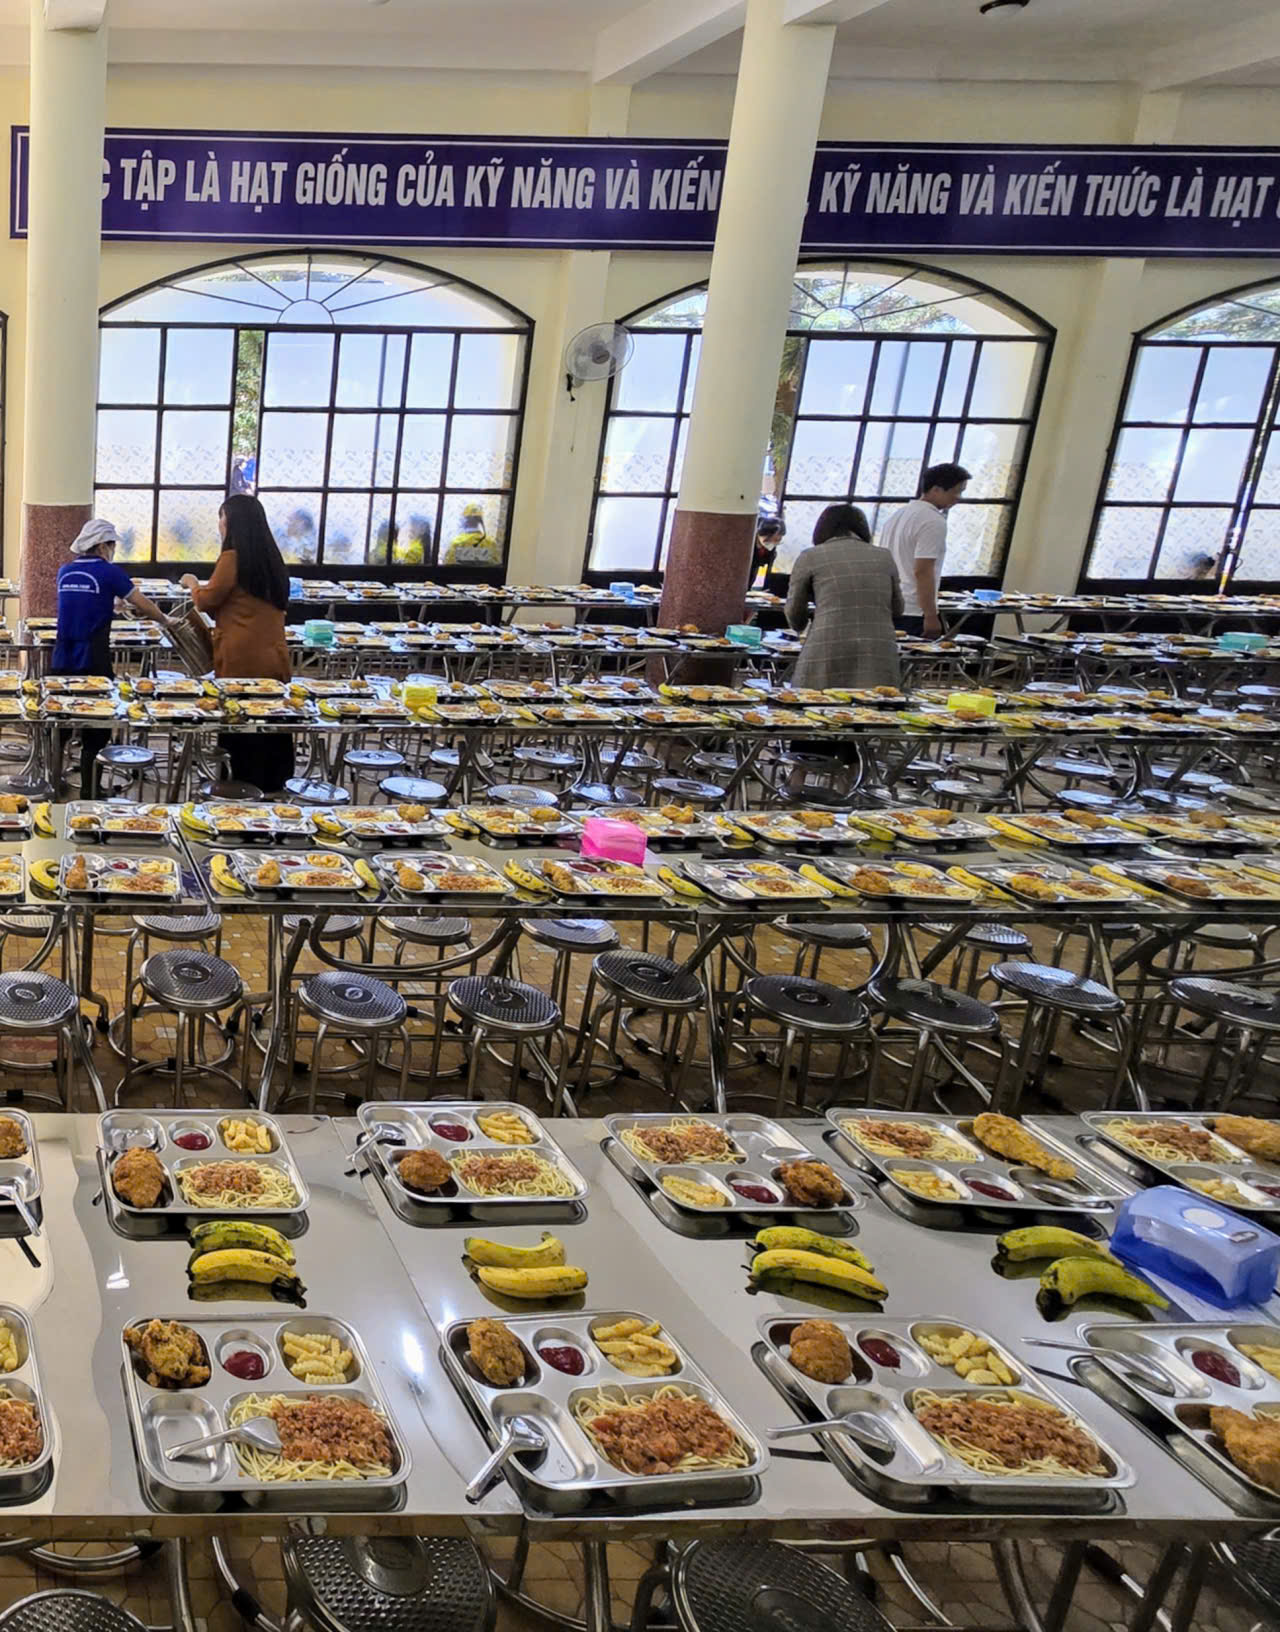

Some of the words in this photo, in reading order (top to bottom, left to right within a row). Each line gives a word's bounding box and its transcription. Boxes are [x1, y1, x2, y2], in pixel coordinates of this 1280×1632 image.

[120, 149, 177, 211] TẬP
[185, 151, 221, 203] LÀ
[230, 161, 288, 213] HẠT
[295, 147, 388, 207] GIỐNG
[396, 150, 455, 207] CỦA
[464, 157, 505, 208] KỸ
[511, 157, 596, 210] NĂNG
[605, 159, 640, 210] VÀ
[649, 155, 722, 211] KIẾN
[819, 163, 862, 213] KỸ
[865, 163, 952, 215] NĂNG
[959, 164, 995, 215] VÀ
[1002, 160, 1078, 216] KIẾN
[1083, 166, 1161, 217] THỨC
[1164, 167, 1204, 217] LÀ
[1209, 176, 1275, 227] HẠT
